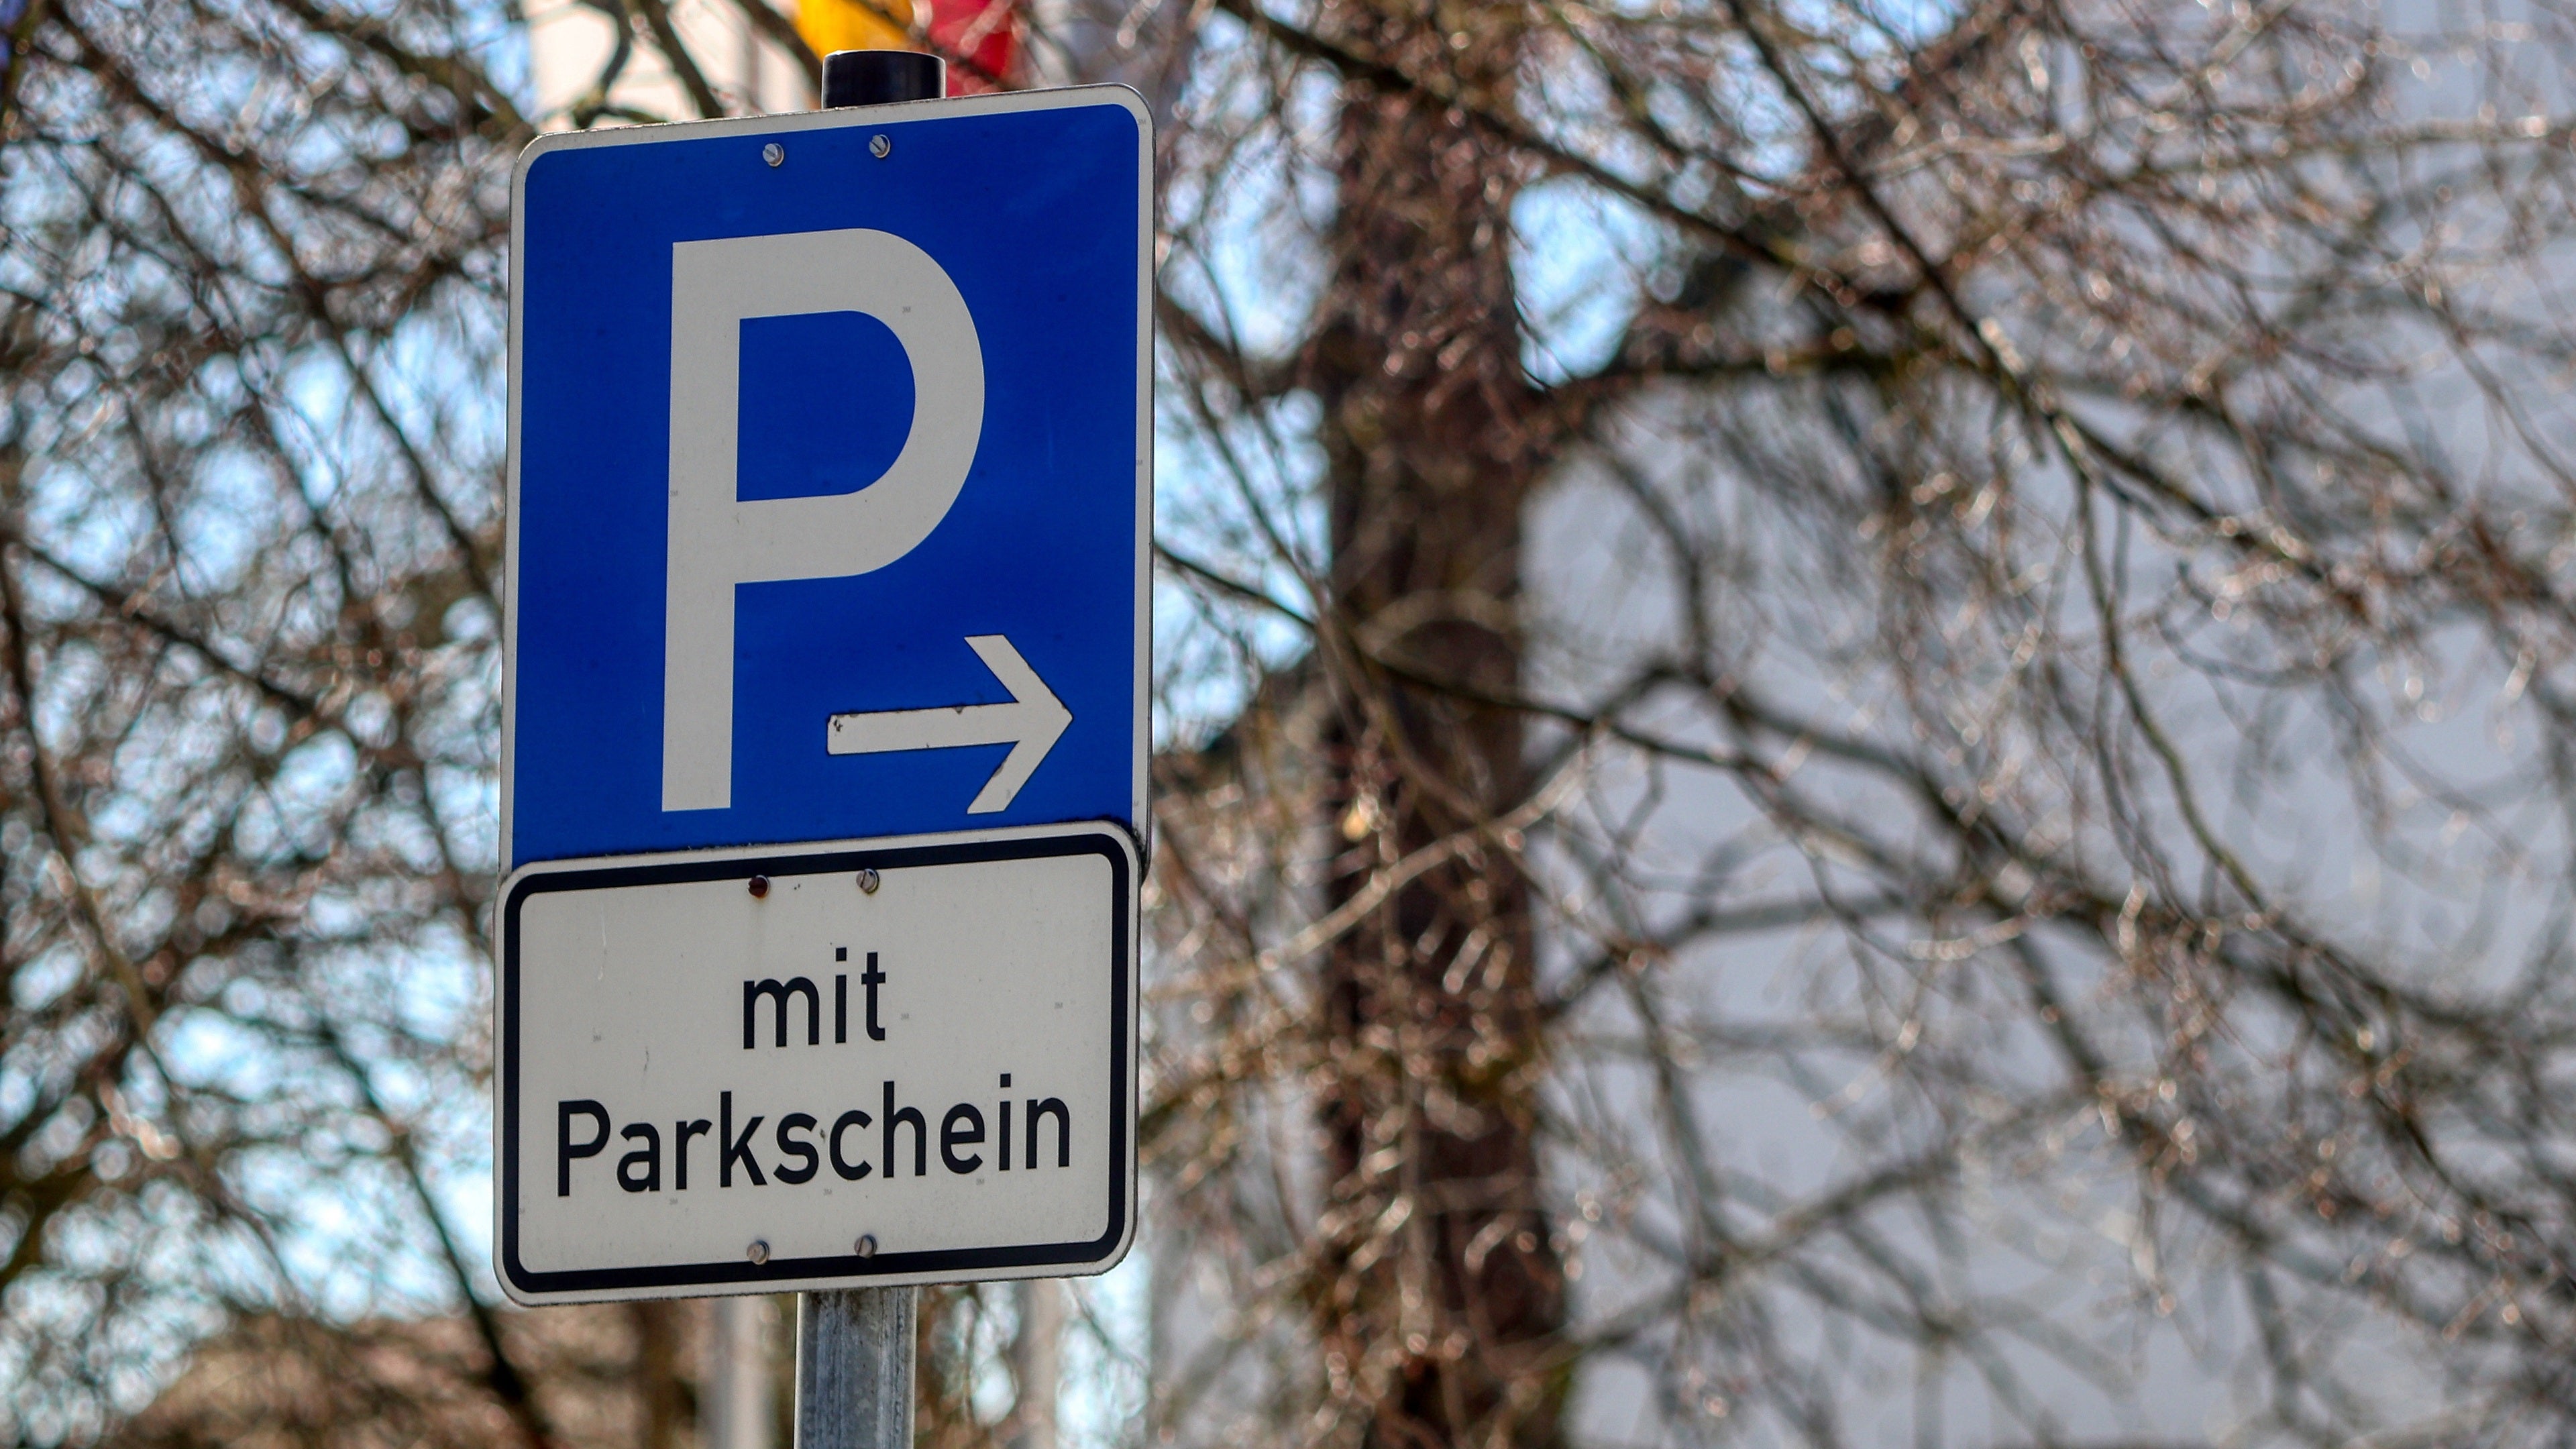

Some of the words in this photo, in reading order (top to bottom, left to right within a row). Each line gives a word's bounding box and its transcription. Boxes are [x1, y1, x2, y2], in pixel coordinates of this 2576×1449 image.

[661, 227, 985, 811] P
[743, 947, 886, 1051] mit
[557, 1073, 1071, 1197] Parkschein
